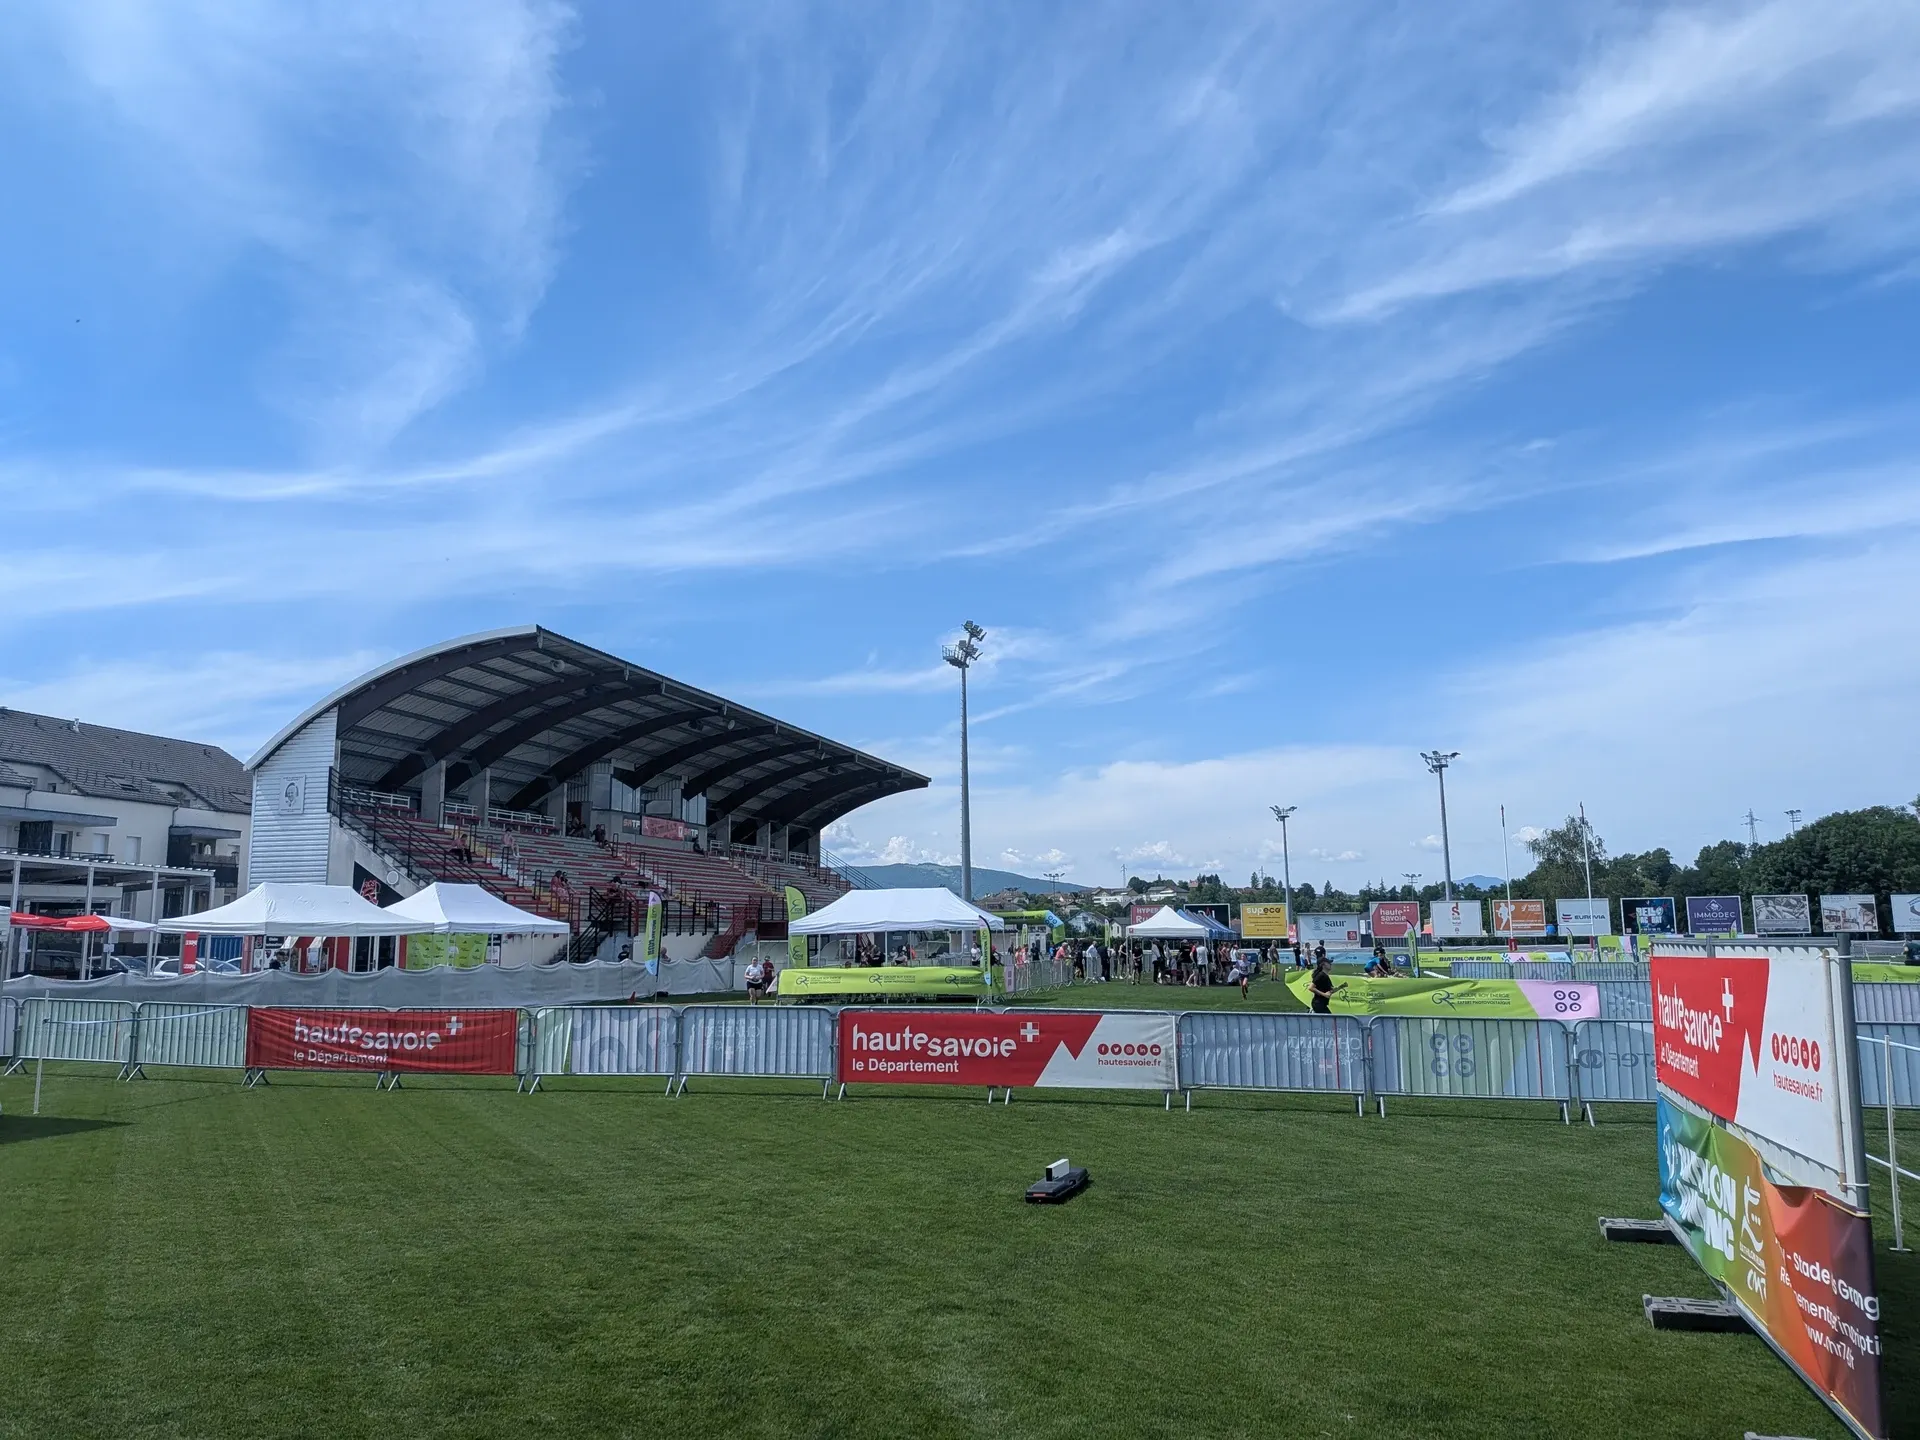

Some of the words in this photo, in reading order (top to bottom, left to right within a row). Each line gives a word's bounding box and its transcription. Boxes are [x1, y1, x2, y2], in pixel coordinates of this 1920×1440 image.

[1246, 907, 1281, 916] supeco
[1380, 908, 1403, 916] haute
[1693, 911, 1736, 919] IMMODEC
[1380, 914, 1407, 922] savoie
[1324, 920, 1346, 928] saur
[293, 1049, 304, 1060] le
[307, 1049, 389, 1065] Département
[1098, 1057, 1162, 1068] hautesavoie.fr
[1660, 1039, 1666, 1062] le
[1665, 1041, 1700, 1080] Département
[852, 1058, 864, 1072] le
[868, 1058, 959, 1074] Département
[1772, 1069, 1823, 1103] hautesavoie.fr
[1793, 1252, 1831, 1285] Stade
